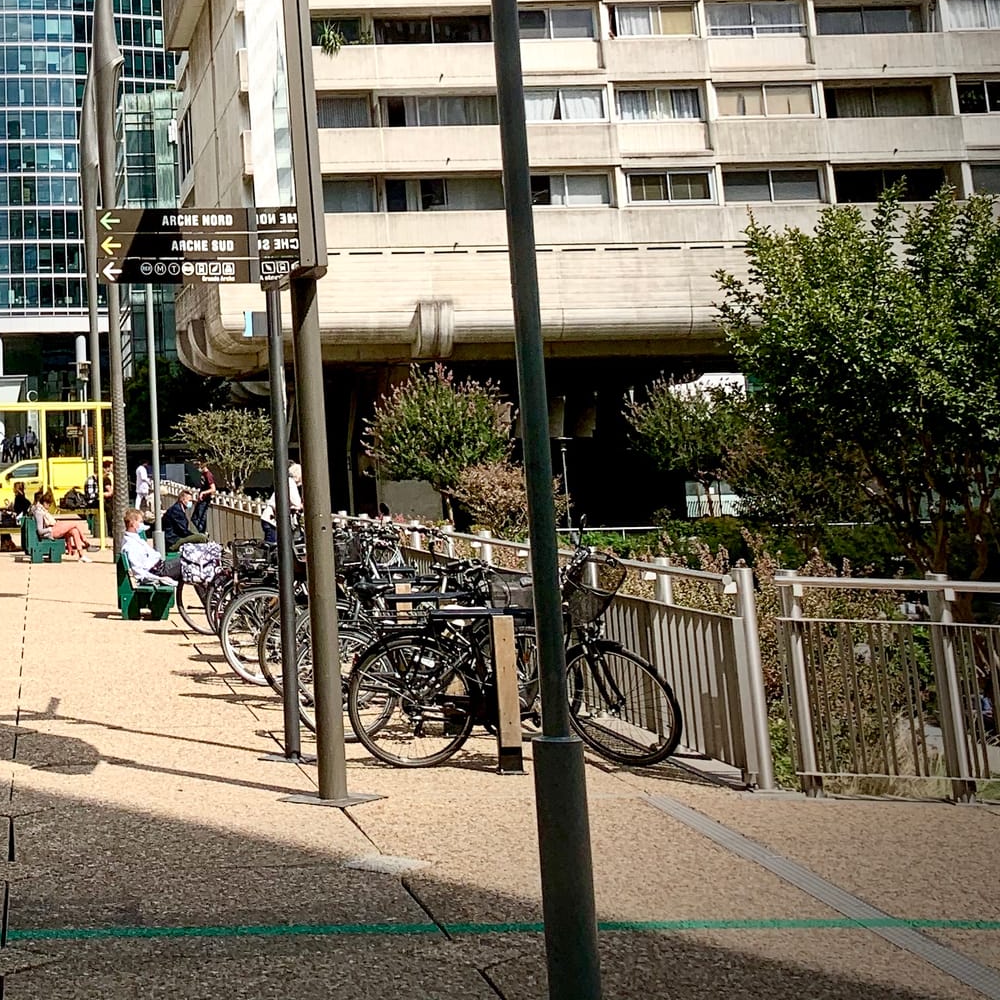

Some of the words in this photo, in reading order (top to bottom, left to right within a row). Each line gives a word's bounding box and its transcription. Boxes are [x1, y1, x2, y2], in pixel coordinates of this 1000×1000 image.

[161, 214, 199, 227] ARCHE
[202, 214, 233, 227] NORD
[171, 239, 209, 252] ARCHE
[211, 239, 235, 252] SUD
